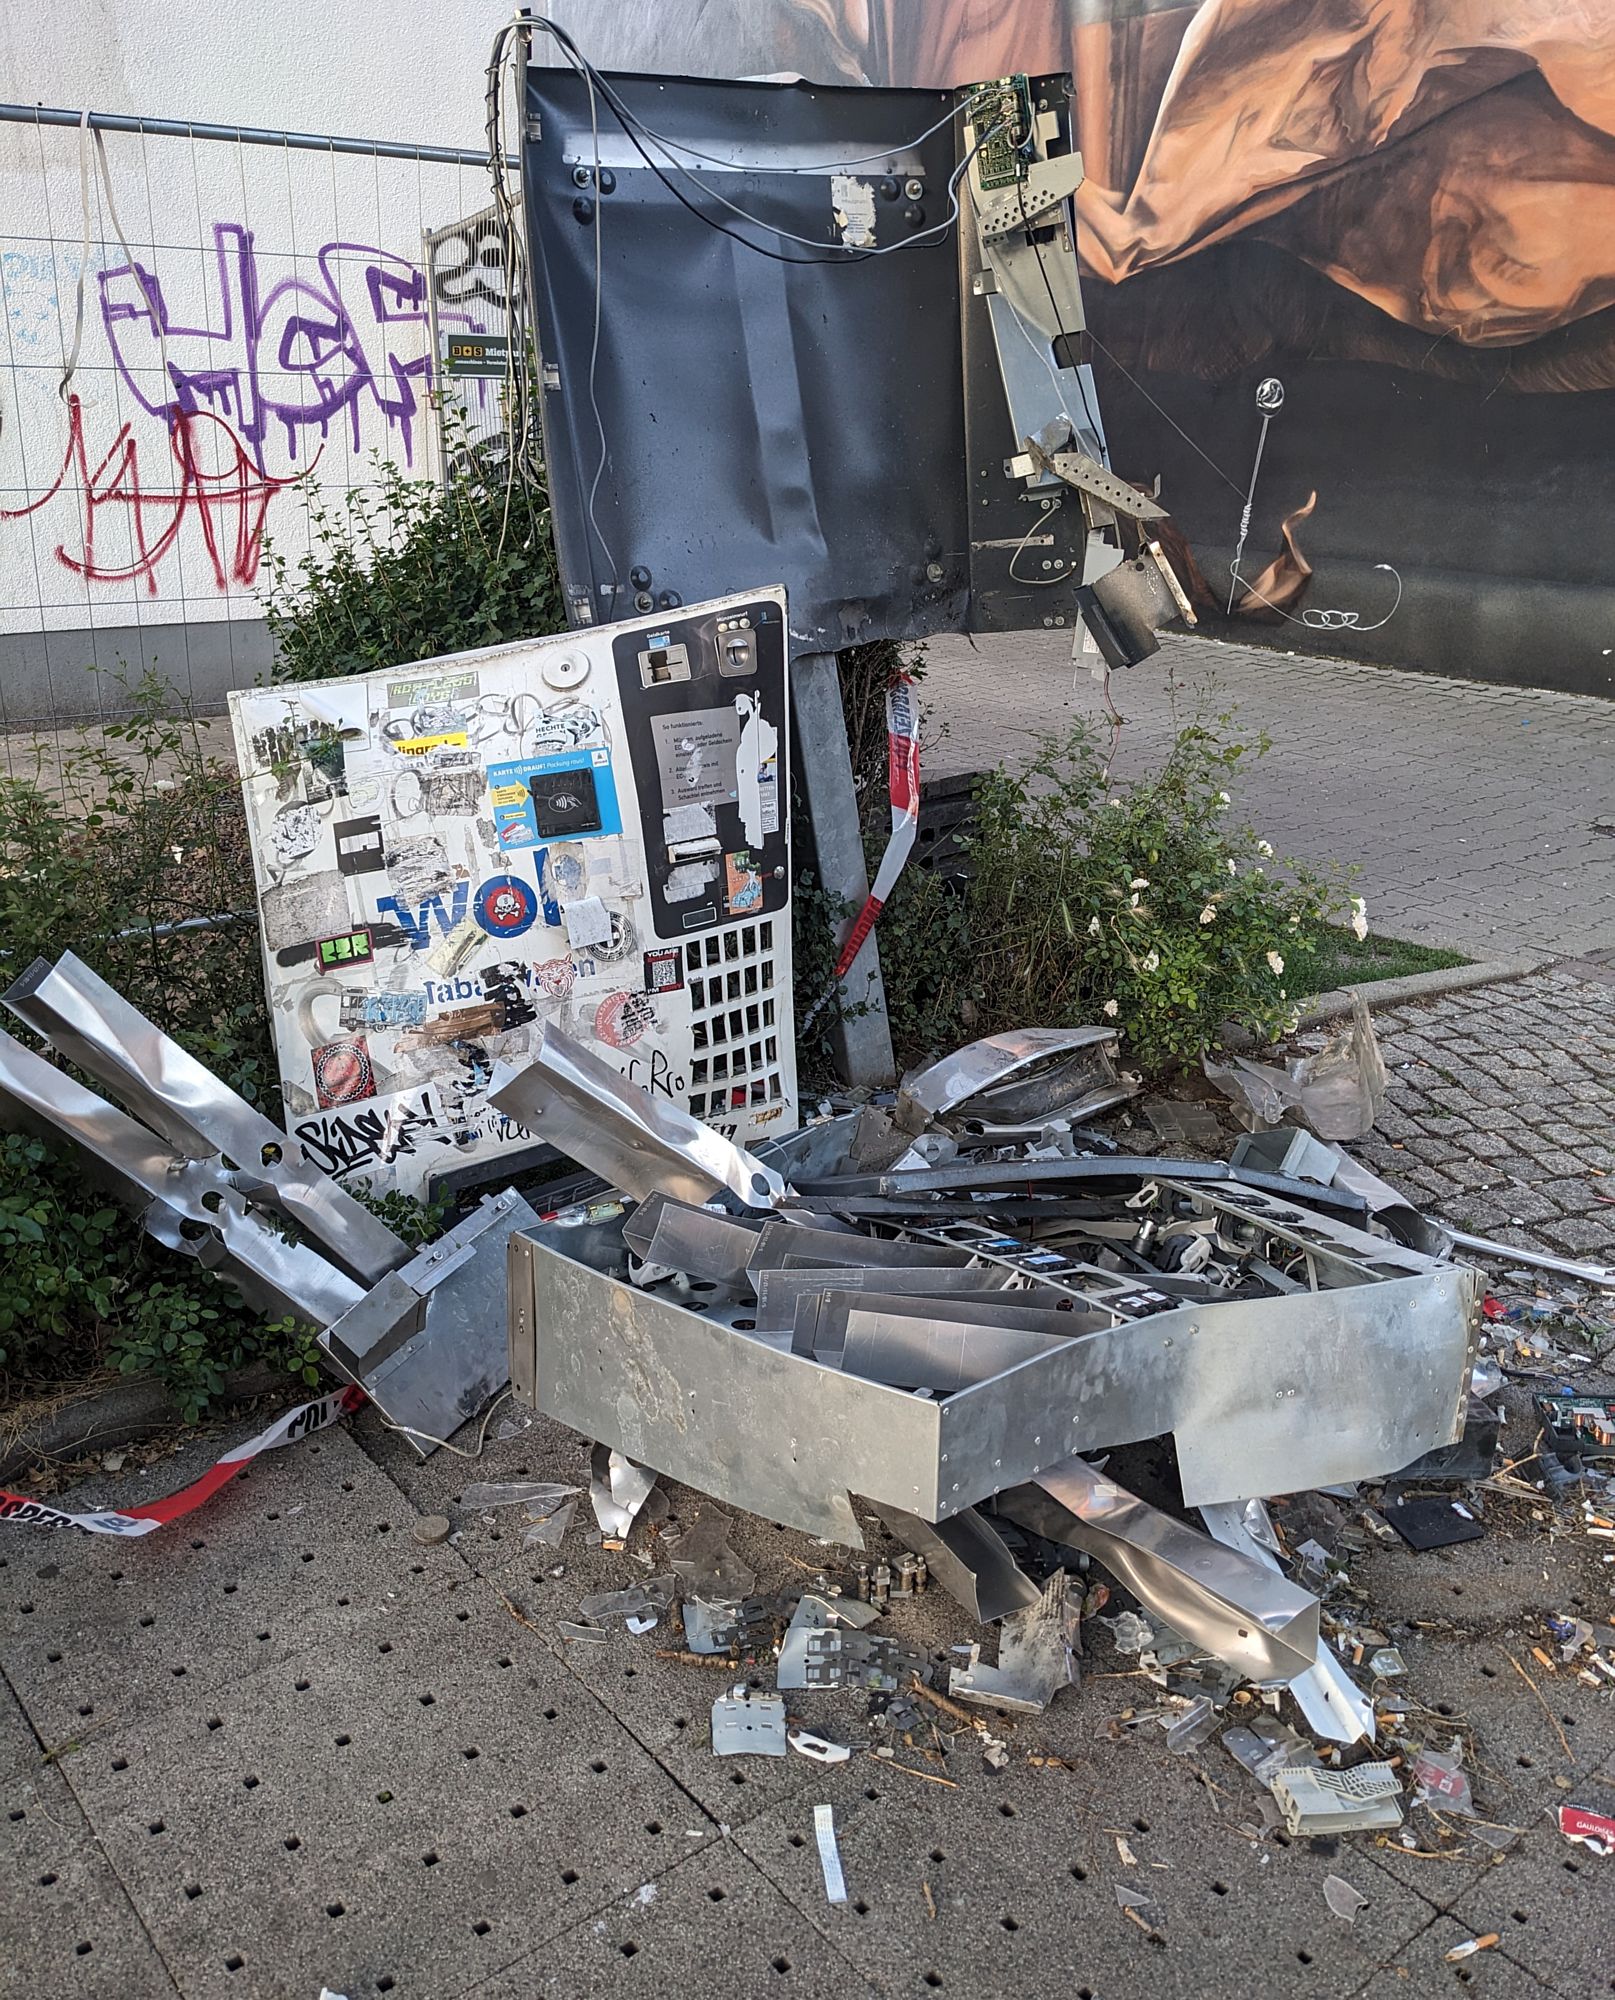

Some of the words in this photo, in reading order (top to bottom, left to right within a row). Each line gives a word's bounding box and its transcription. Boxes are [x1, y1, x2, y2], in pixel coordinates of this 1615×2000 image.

[716, 611, 748, 622] Münzeinwurf
[646, 630, 670, 639] Geldkarte
[697, 740, 708, 748] oder
[708, 738, 733, 747] Geldschein
[493, 769, 513, 777] KARTE
[546, 761, 570, 770] Packung
[647, 949, 663, 957] YOU
[663, 947, 680, 956] ARE
[647, 987, 660, 995] I'M
